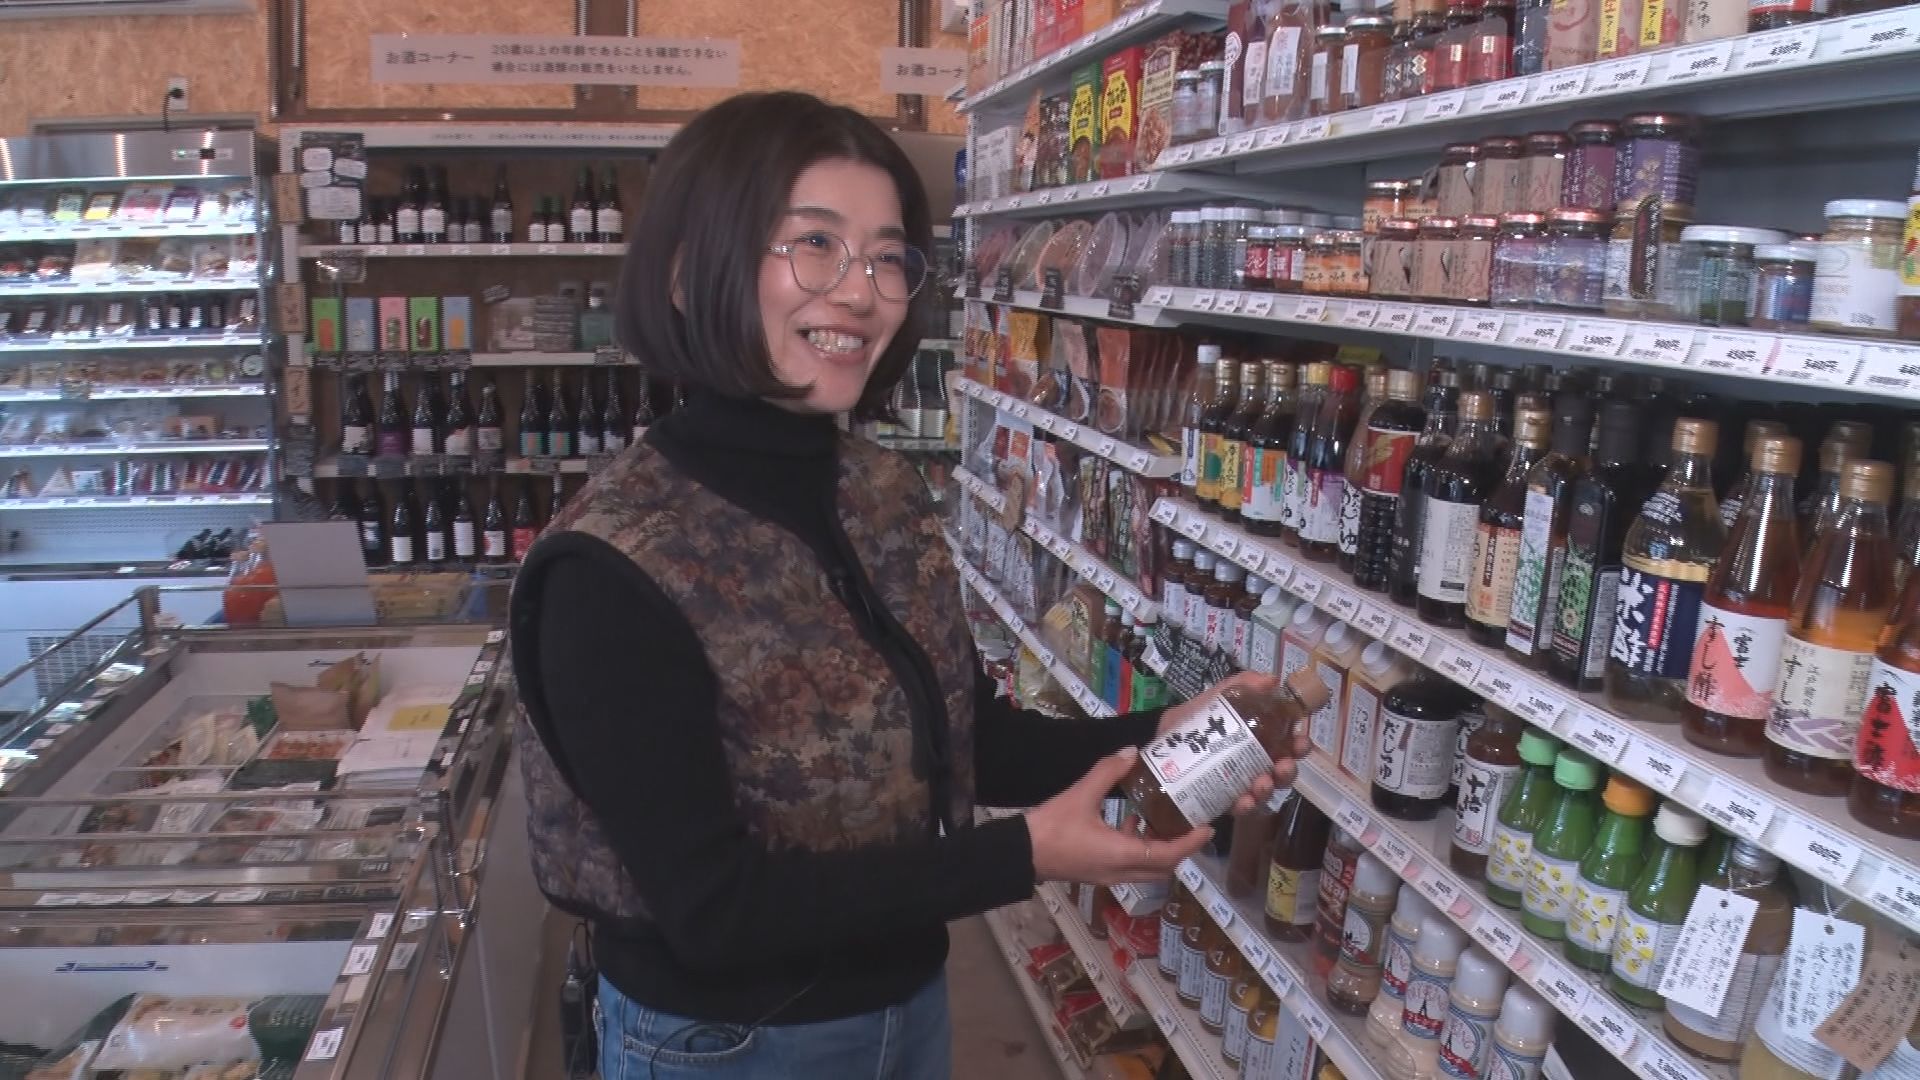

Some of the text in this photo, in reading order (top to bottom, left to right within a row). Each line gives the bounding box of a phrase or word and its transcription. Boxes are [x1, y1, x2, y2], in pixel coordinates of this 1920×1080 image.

[385, 50, 475, 65] お酒コーナー
[1693, 615, 1725, 701] すし酢
[1773, 655, 1803, 736] すし酢
